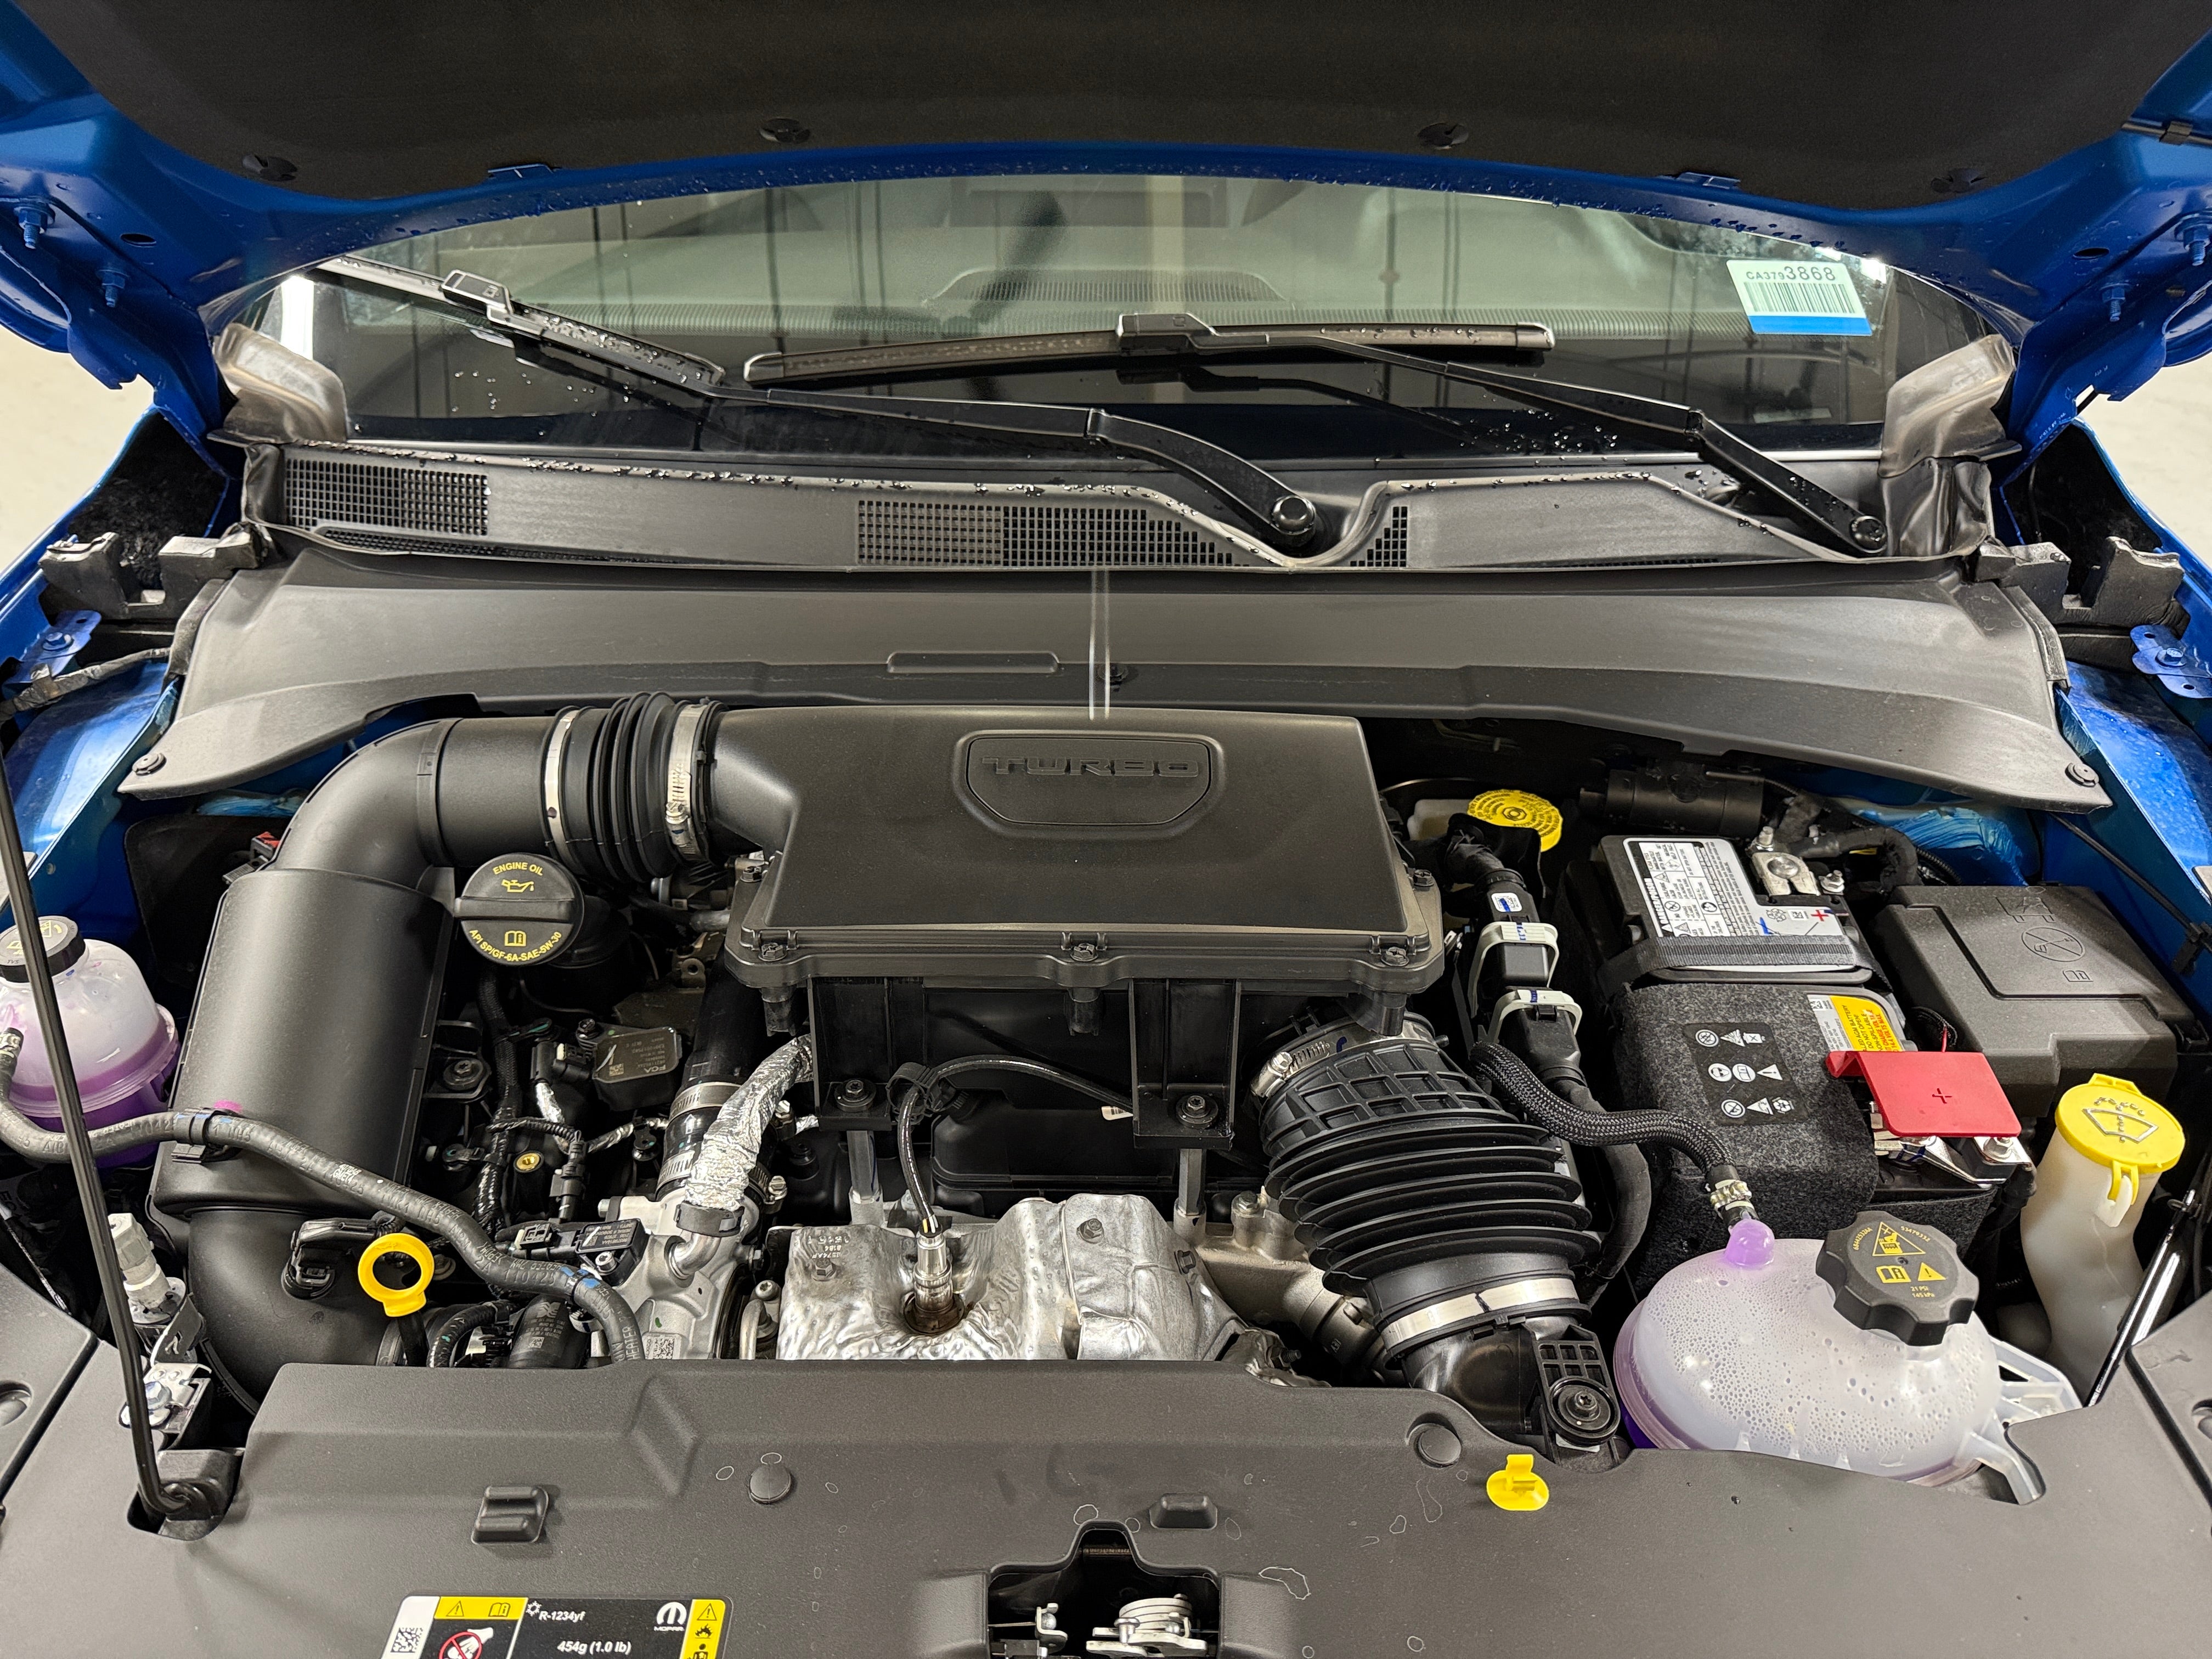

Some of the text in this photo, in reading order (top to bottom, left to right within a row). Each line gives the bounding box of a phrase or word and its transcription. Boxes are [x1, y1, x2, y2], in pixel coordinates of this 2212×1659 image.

[981, 757, 1199, 778] TURBO
[493, 862, 544, 876] ENGINE OIL
[470, 929, 483, 944] API
[1842, 1005, 1855, 1026] BATTERY
[1852, 1026, 1861, 1039] AGM
[1860, 1030, 1870, 1040] NOT
[1876, 1028, 1889, 1046] CHARGE
[644, 1064, 666, 1073] FCA
[622, 1325, 640, 1361] HEATER
[538, 1610, 585, 1622] R-1234yf
[557, 1641, 632, 1655] 454g (1.0 lb)
